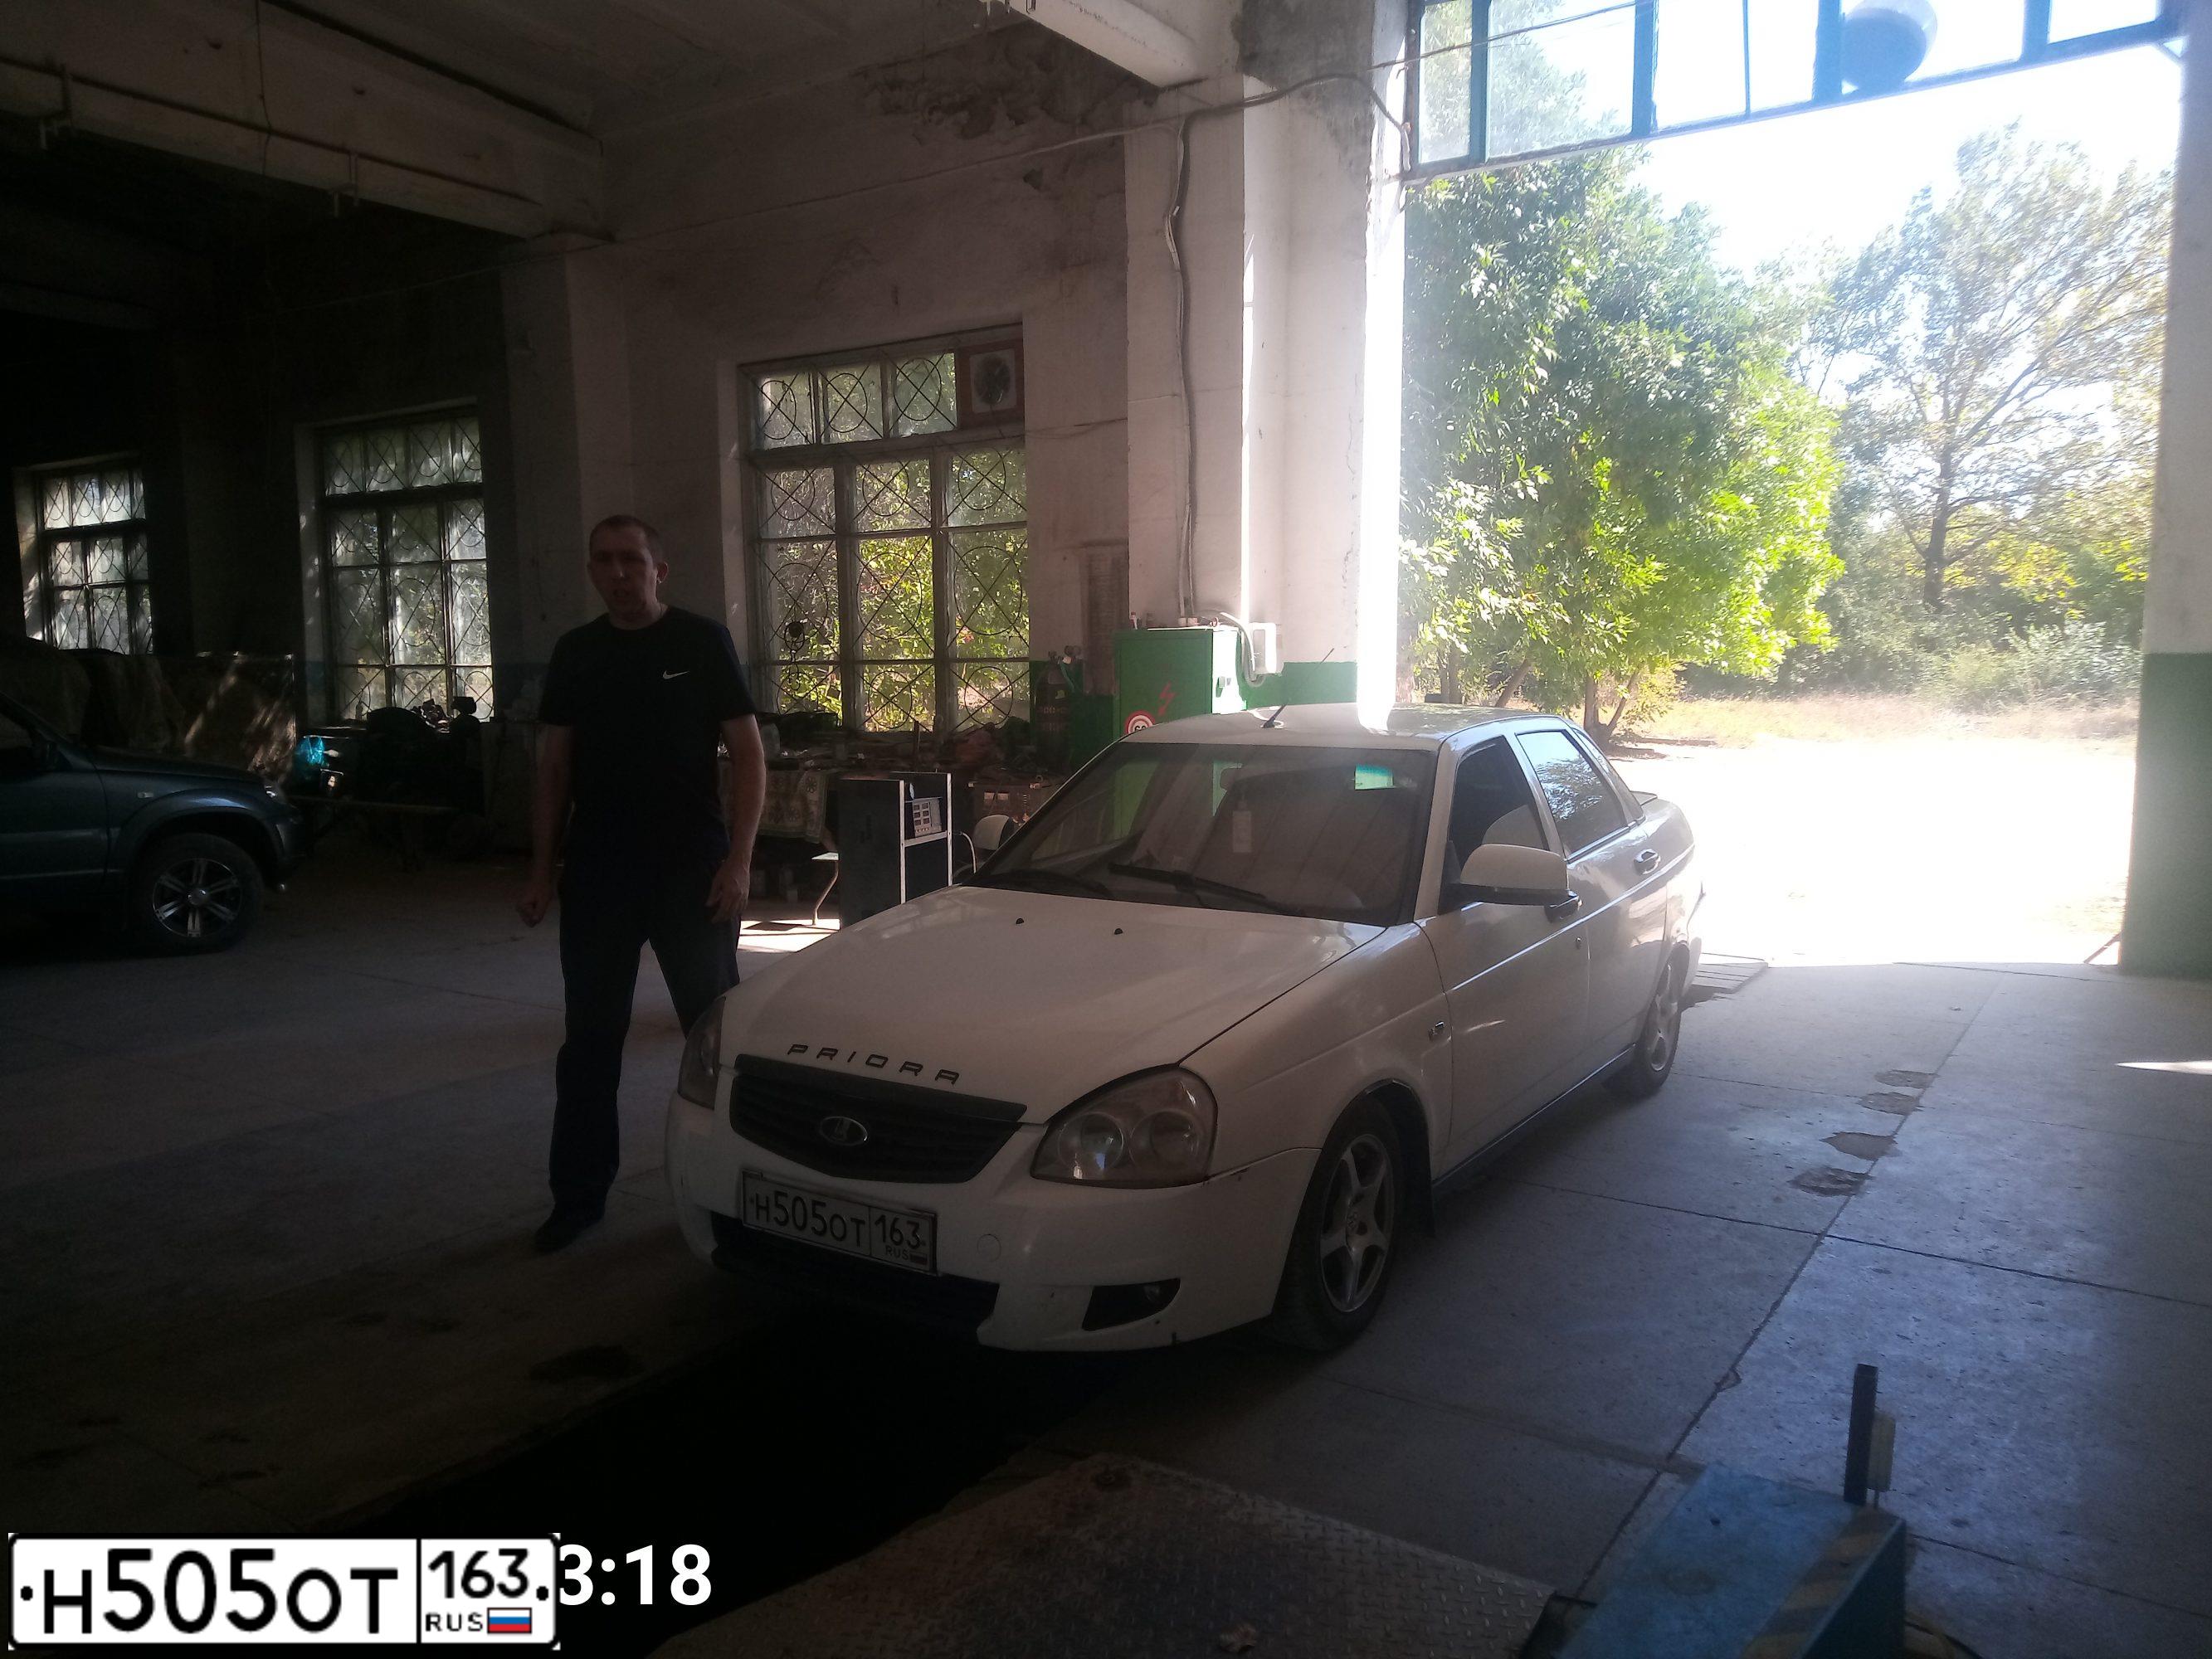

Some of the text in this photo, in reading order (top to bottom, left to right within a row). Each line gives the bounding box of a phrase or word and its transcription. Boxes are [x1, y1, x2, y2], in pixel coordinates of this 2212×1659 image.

[787, 1044, 960, 1084] PRIORA
[875, 1214, 921, 1249] 163
[885, 1245, 909, 1261] RUS
